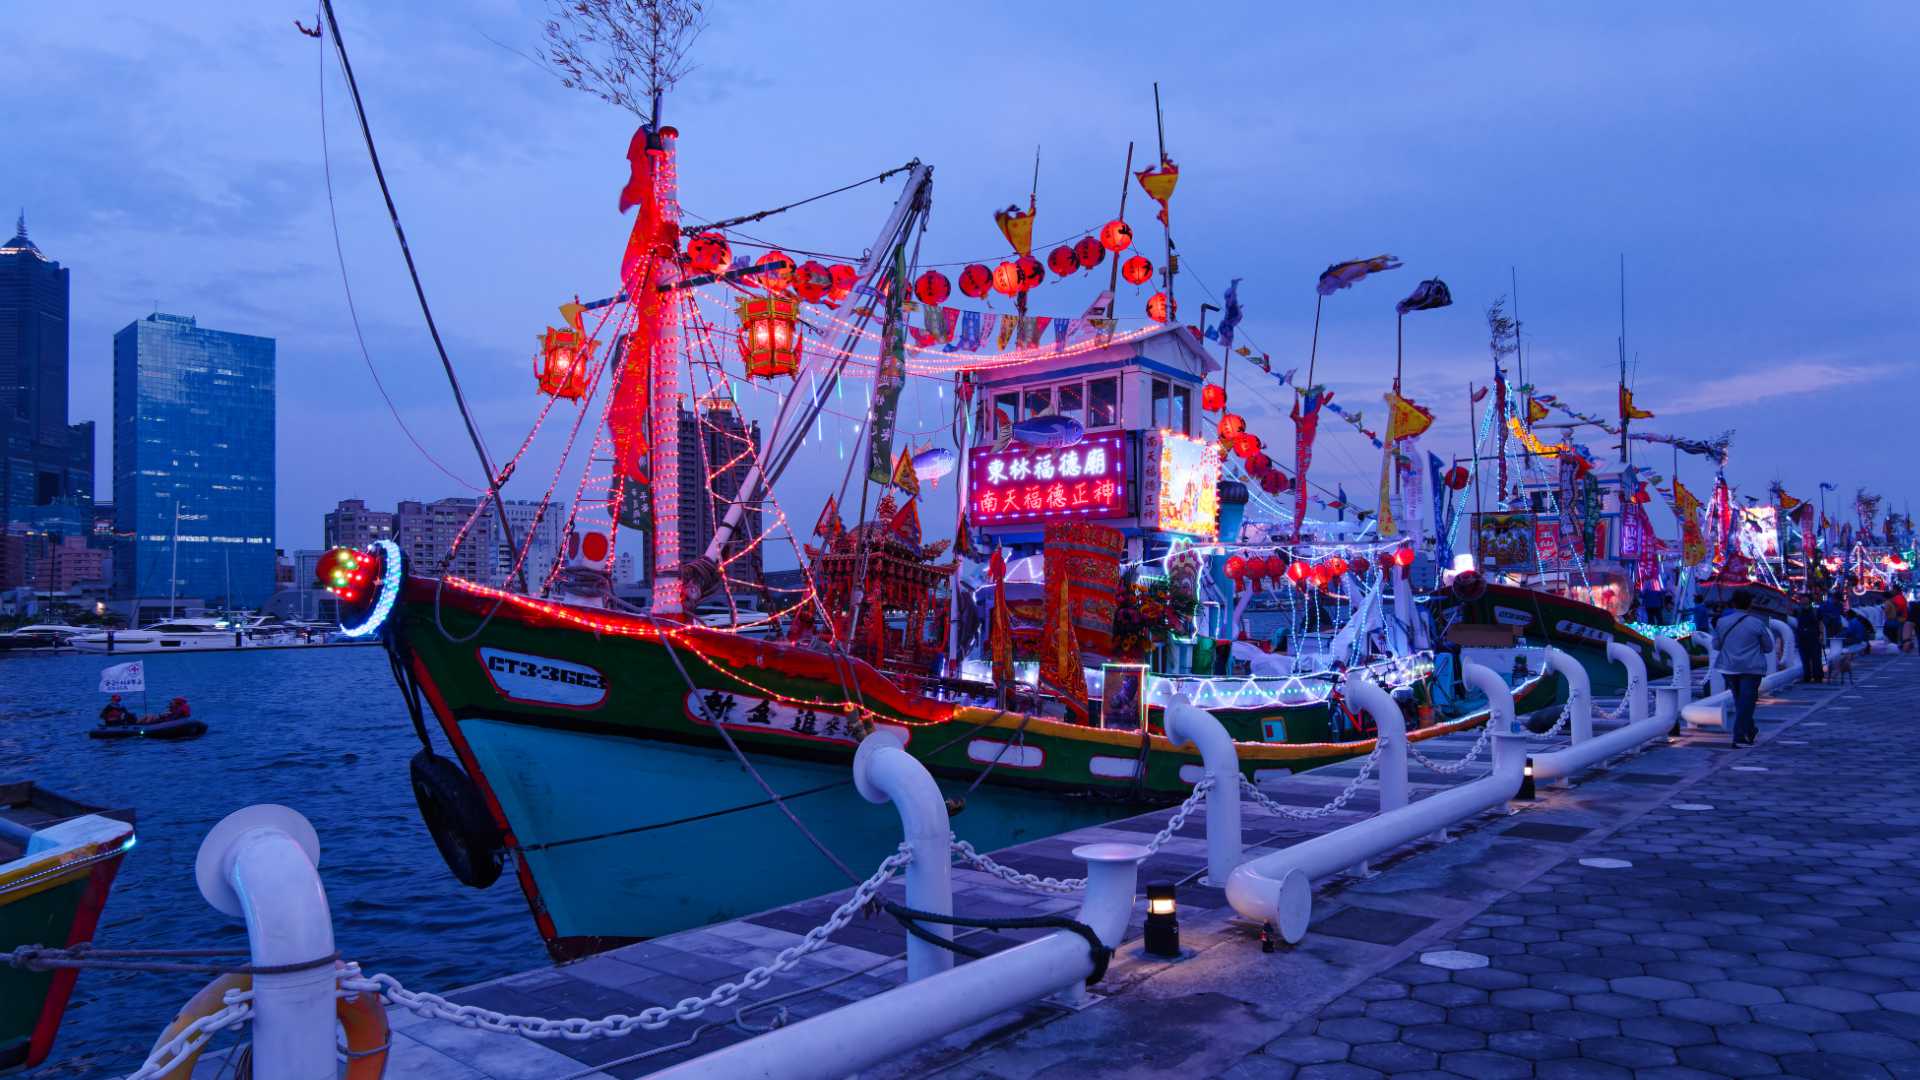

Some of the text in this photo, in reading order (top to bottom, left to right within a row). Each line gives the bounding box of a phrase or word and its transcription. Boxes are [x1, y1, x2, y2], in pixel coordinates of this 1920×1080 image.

[986, 448, 1108, 485] 東林福德廟
[980, 479, 1116, 513] 南天福德正神
